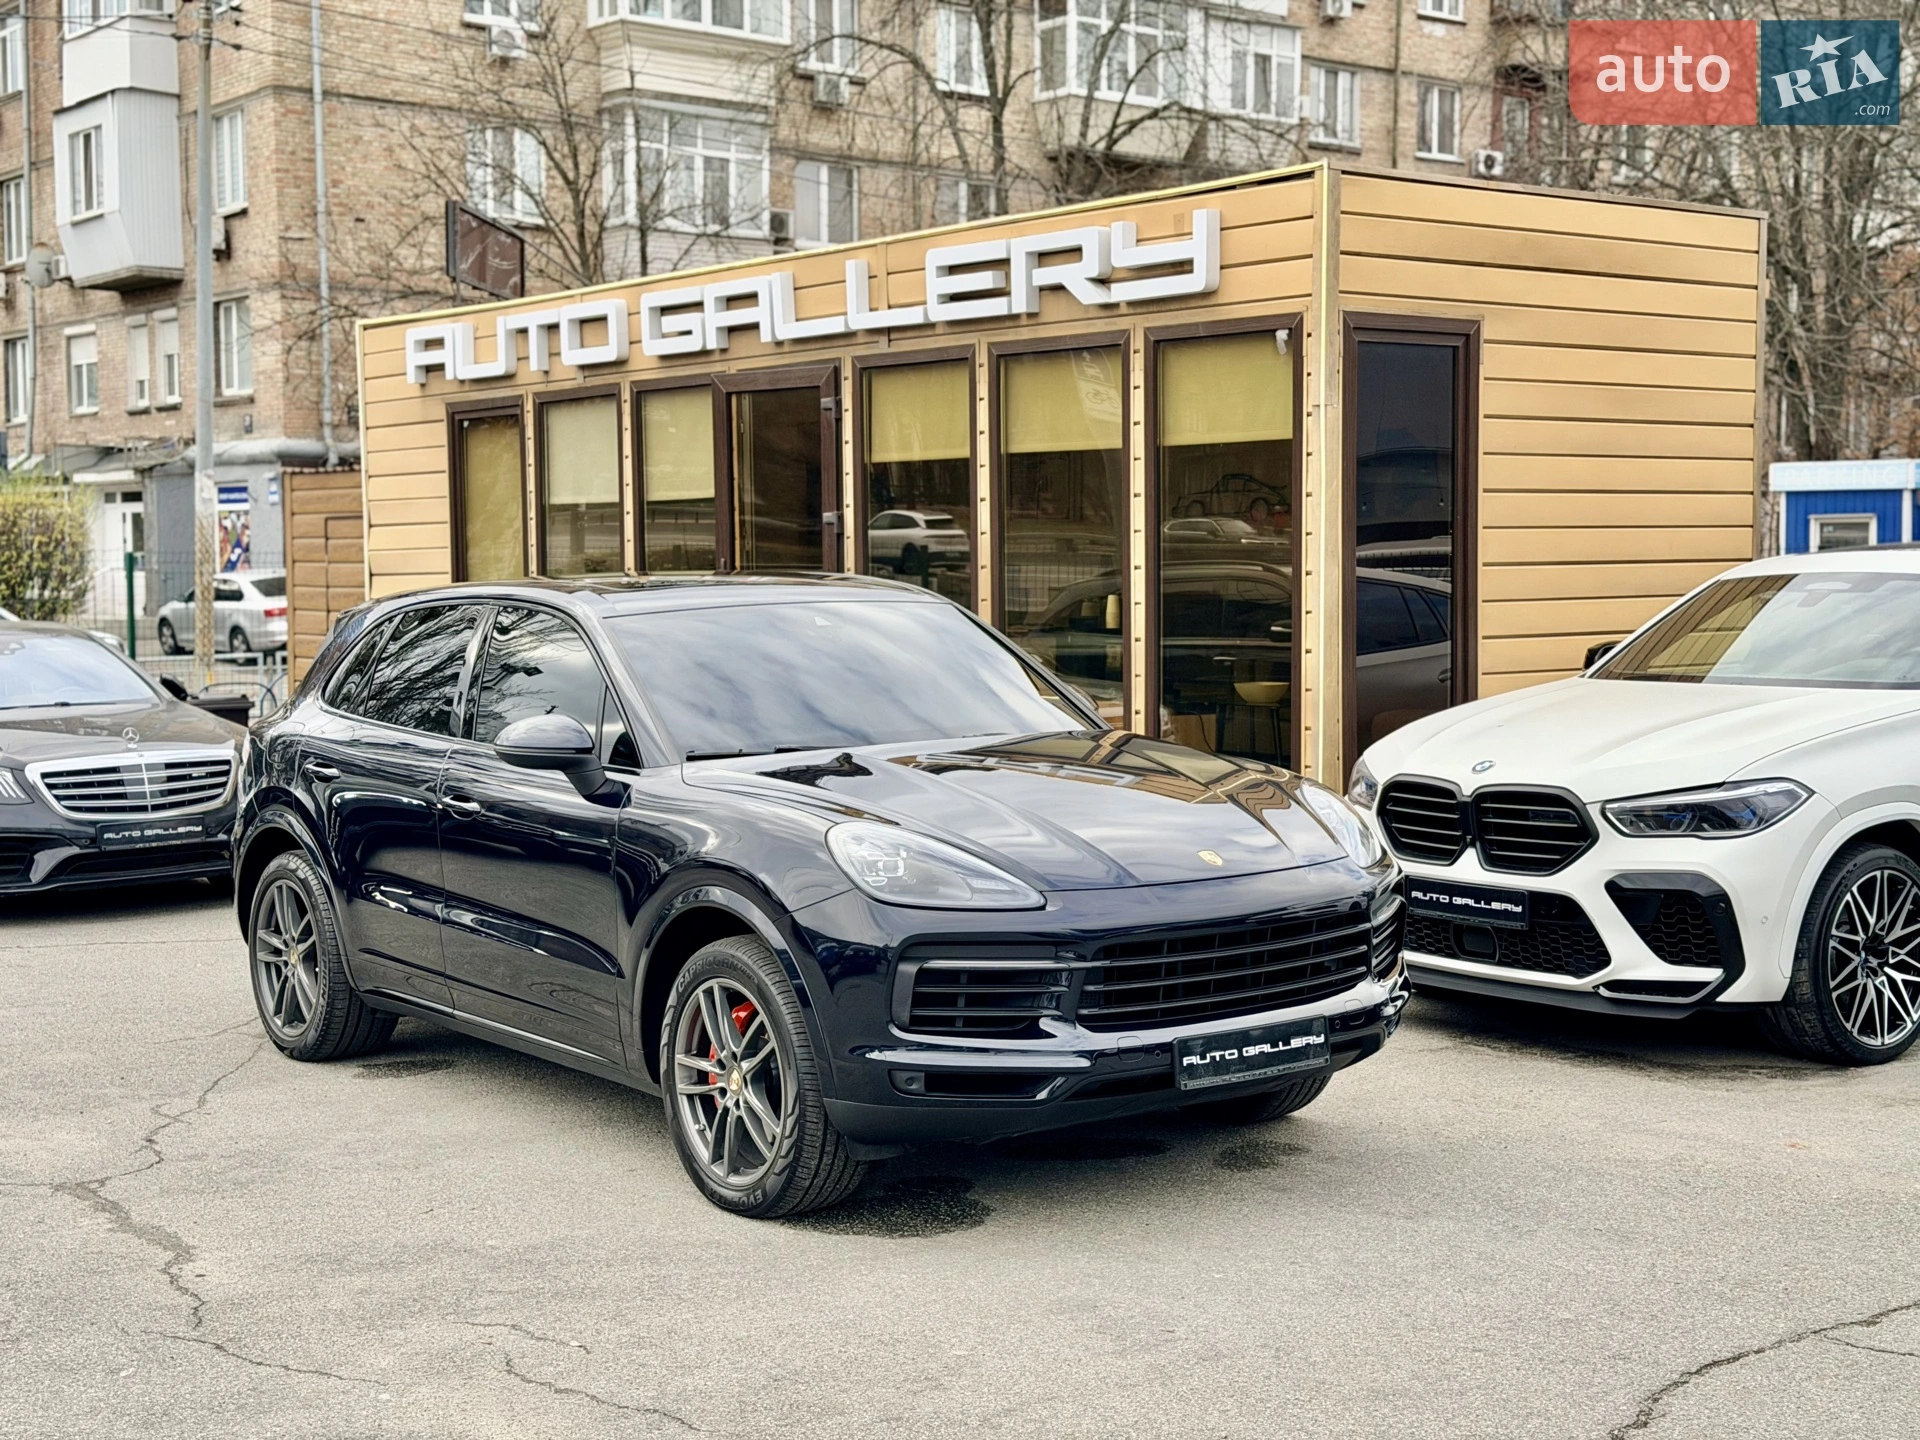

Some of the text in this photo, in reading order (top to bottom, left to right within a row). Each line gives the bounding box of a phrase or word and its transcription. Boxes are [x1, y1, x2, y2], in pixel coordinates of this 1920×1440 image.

[405, 208, 1221, 385] AUTO GALLERY
[1784, 466, 1898, 487] PARKING
[103, 825, 203, 839] AUTO GALLERY
[1411, 891, 1523, 912] AUTO GALLERY
[1182, 1033, 1325, 1067] AUTO GALLERY
